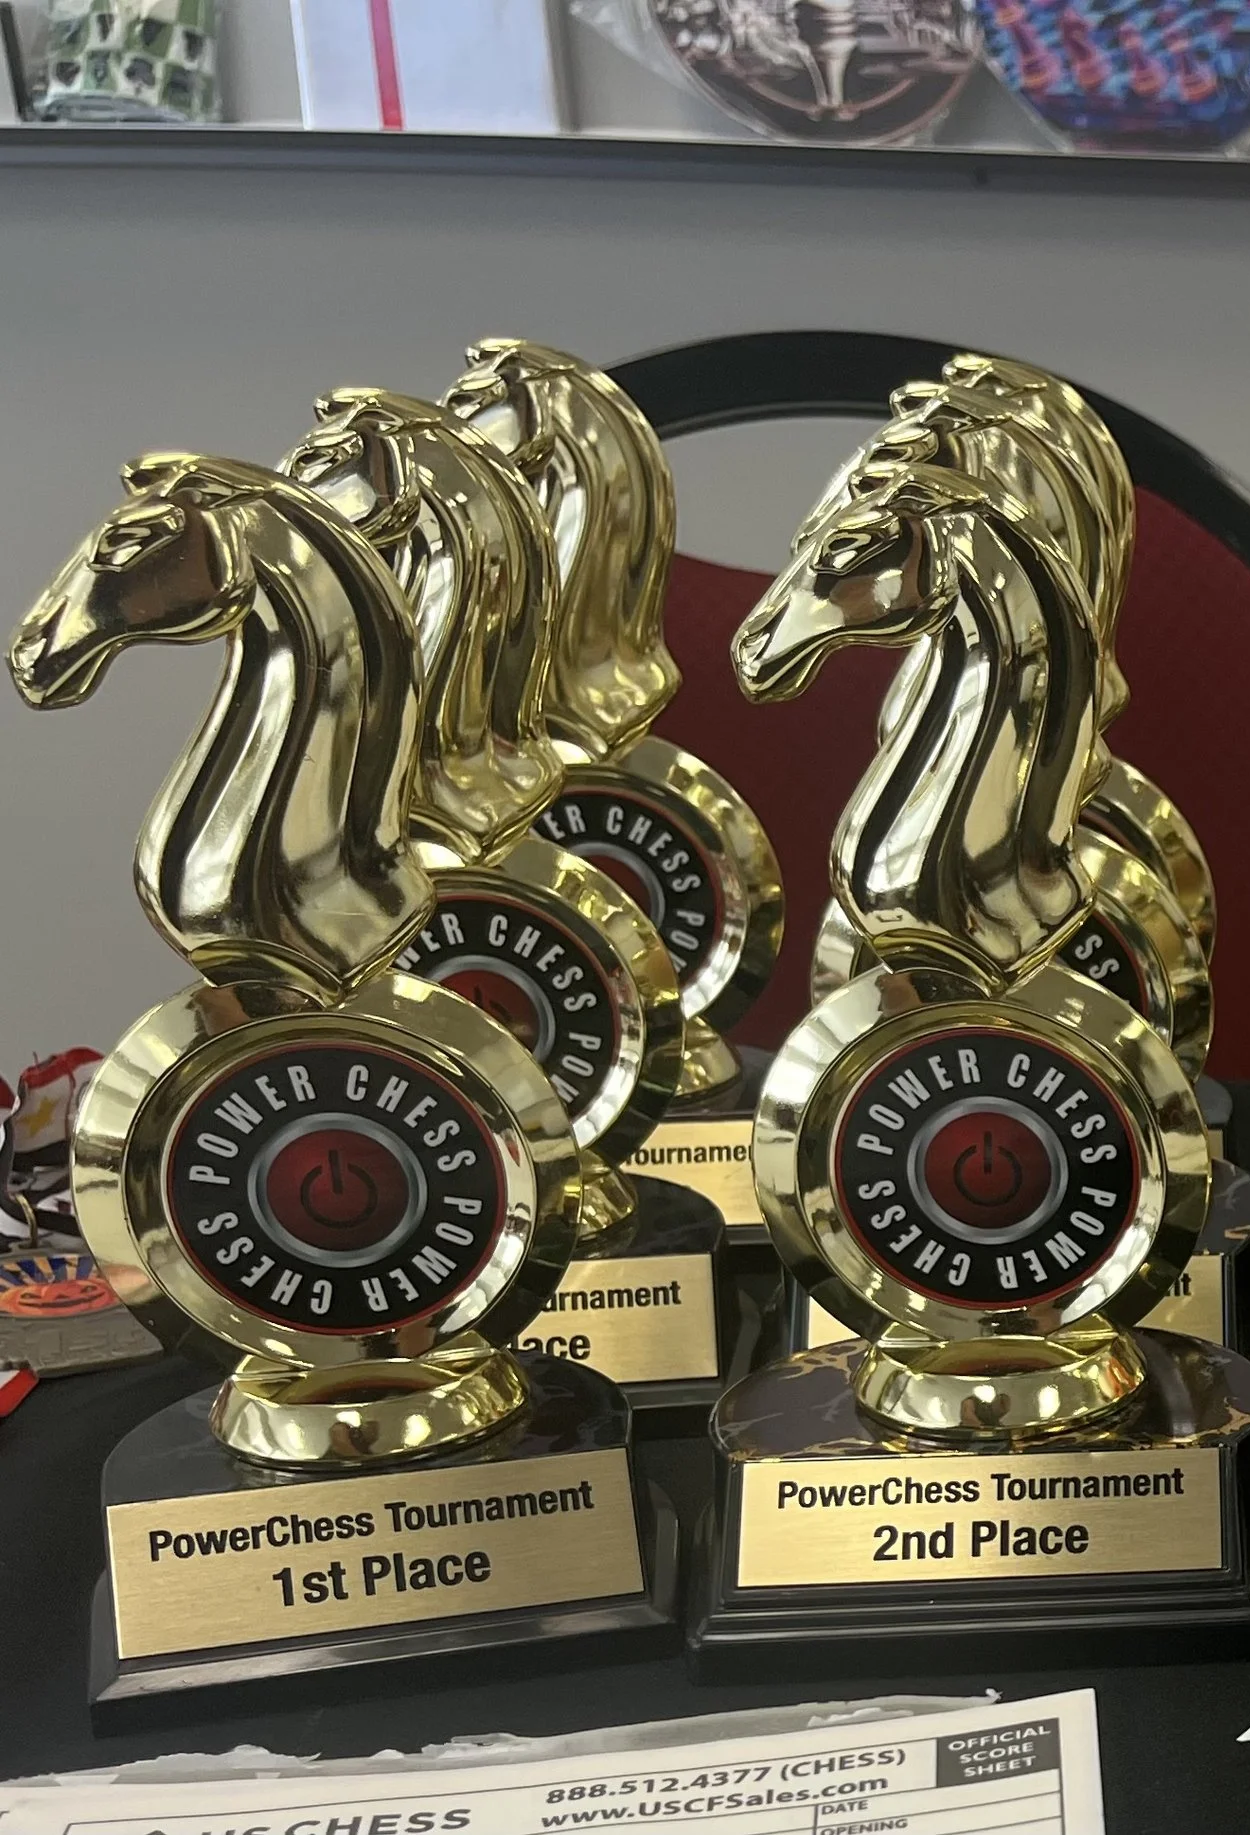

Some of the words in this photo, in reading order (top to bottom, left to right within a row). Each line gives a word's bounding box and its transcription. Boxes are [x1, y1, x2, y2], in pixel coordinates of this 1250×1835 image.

[605, 805, 702, 893] CHESS
[487, 913, 598, 1013] CHESS
[188, 1064, 317, 1186] POWER
[346, 1063, 478, 1173] CHESS
[856, 1048, 982, 1156] POWER
[1006, 1052, 1118, 1165] CHESS
[196, 1210, 333, 1316] CHESS
[360, 1195, 484, 1313] POWER
[857, 1178, 972, 1287] CHESS
[995, 1185, 1118, 1290] POWER
[149, 1512, 375, 1562] PowerChess
[384, 1481, 595, 1534] Tournament
[778, 1476, 980, 1509] PowerChess
[990, 1467, 1185, 1501] Tournament
[873, 1521, 954, 1561] 2nd
[971, 1519, 1090, 1558] Place
[272, 1560, 349, 1607] 1st
[362, 1549, 492, 1597] Place
[947, 1725, 1051, 1751] OFFICIAL
[959, 1741, 1034, 1764] SCORE
[964, 1755, 1037, 1777] SHEET
[541, 1777, 889, 1829] www.USCFSales.com
[546, 1765, 772, 1805] 888.512.4377
[780, 1748, 907, 1782] (CHESS)
[821, 1800, 869, 1816] DATE
[284, 1808, 472, 1835] CHESS
[820, 1818, 909, 1835] OPENING
